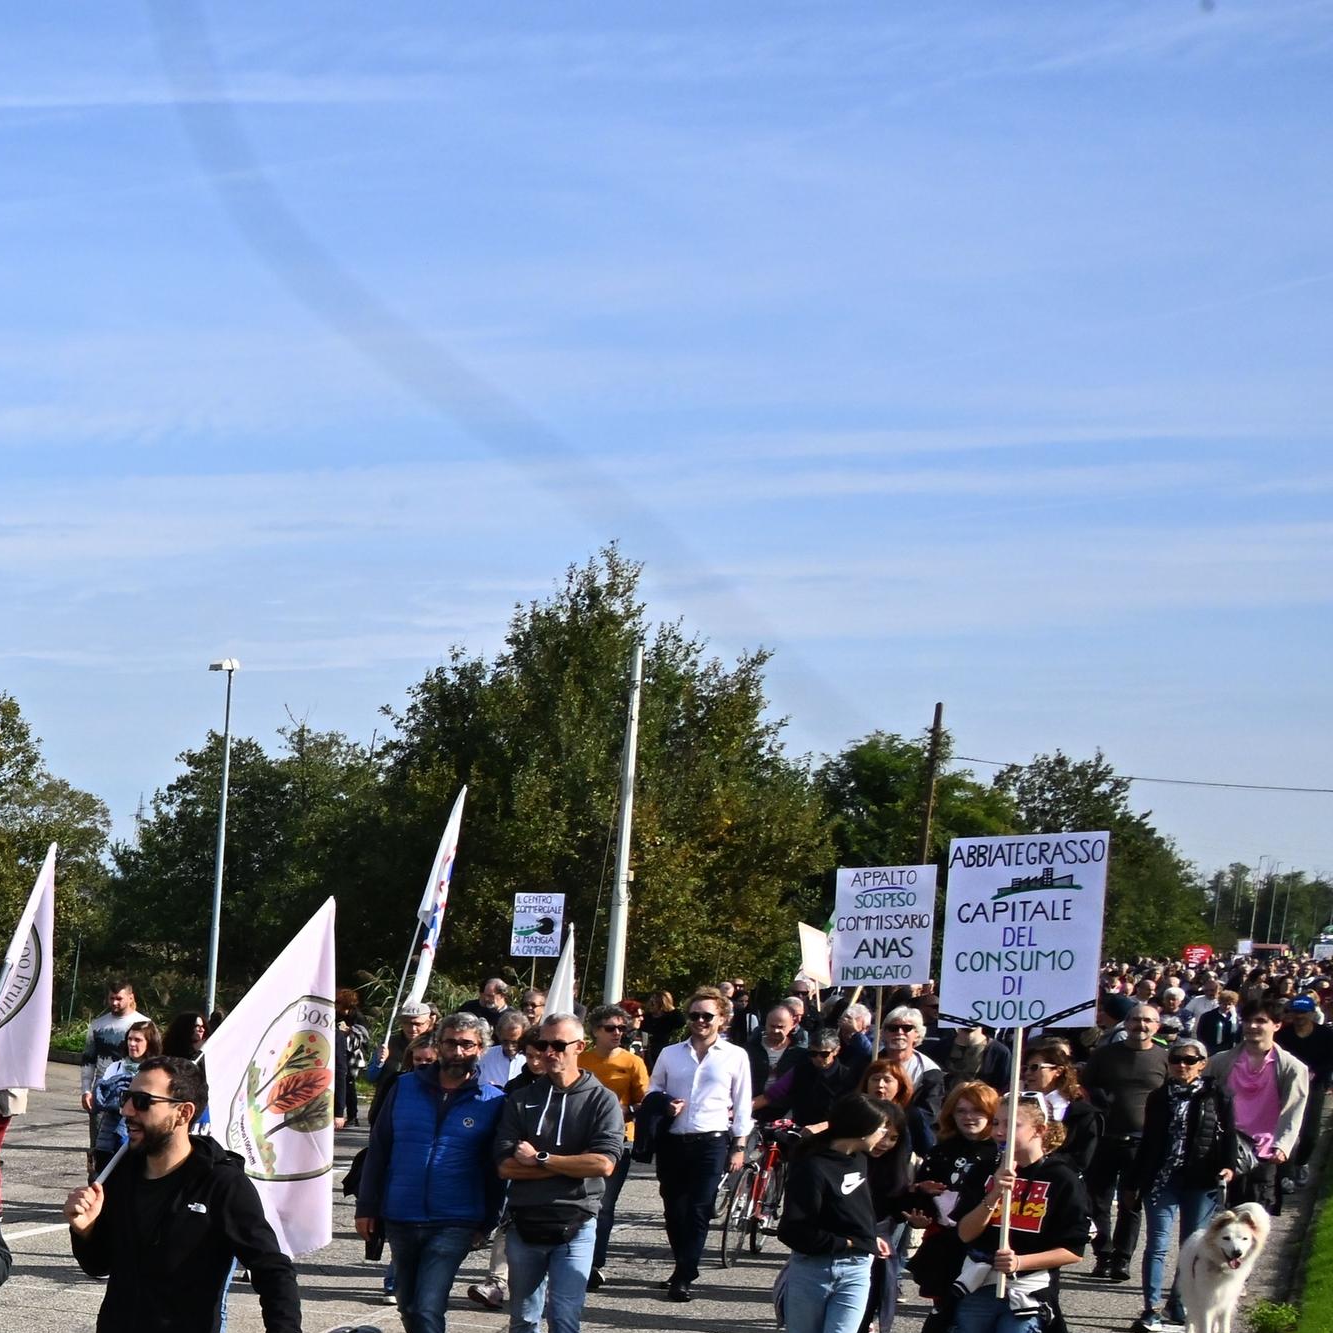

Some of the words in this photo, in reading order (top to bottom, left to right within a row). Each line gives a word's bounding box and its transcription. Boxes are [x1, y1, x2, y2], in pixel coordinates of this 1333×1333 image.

[949, 839, 1105, 869] ABBIATEGRASSO
[851, 870, 918, 887] APPALTO
[523, 895, 552, 904] CENTRO
[854, 892, 917, 909] SOSPESO
[957, 899, 1073, 923] CAPITALE
[837, 914, 930, 932] COMMISSARIO
[1002, 926, 1038, 947] DEL
[853, 936, 914, 959] ANAS
[955, 949, 1075, 972] CONSUMO
[841, 964, 912, 981] INDAGATO
[1002, 975, 1023, 996] DI
[969, 999, 1046, 1022] SUOLO
